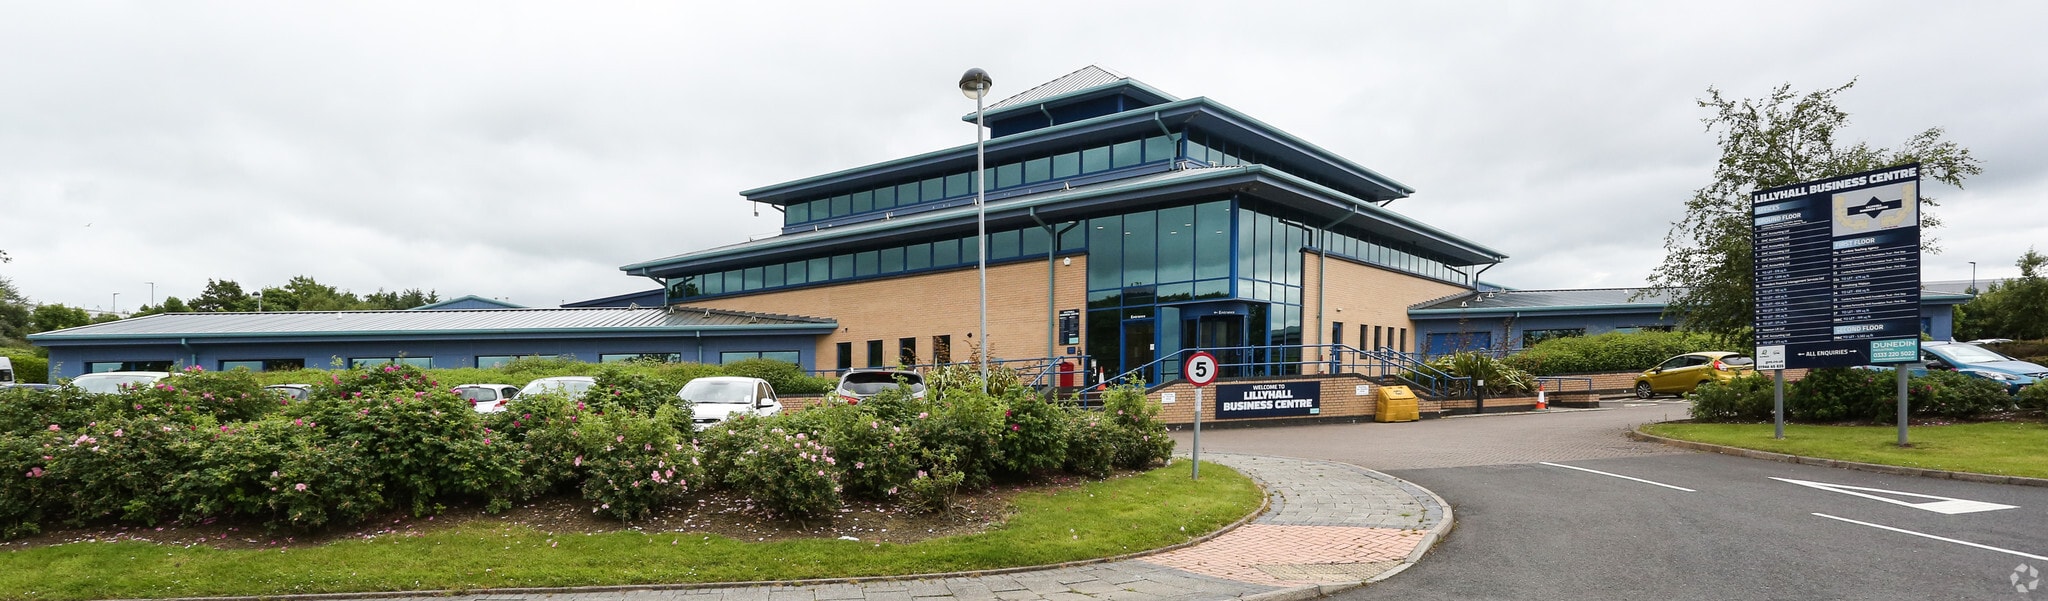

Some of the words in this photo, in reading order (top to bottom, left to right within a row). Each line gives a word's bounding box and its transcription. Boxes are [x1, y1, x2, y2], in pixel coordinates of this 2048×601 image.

[1754, 188, 1807, 203] LILLYHALL
[1809, 175, 1867, 194] BUSINESS
[1868, 167, 1917, 184] CENTRE
[1782, 212, 1802, 220] FLOOR
[1854, 237, 1875, 245] FLOOR
[1196, 362, 1207, 377] 5
[1244, 390, 1293, 400] LILLYHALL
[1223, 400, 1273, 411] BUSINESS
[1275, 399, 1312, 409] CENTRE
